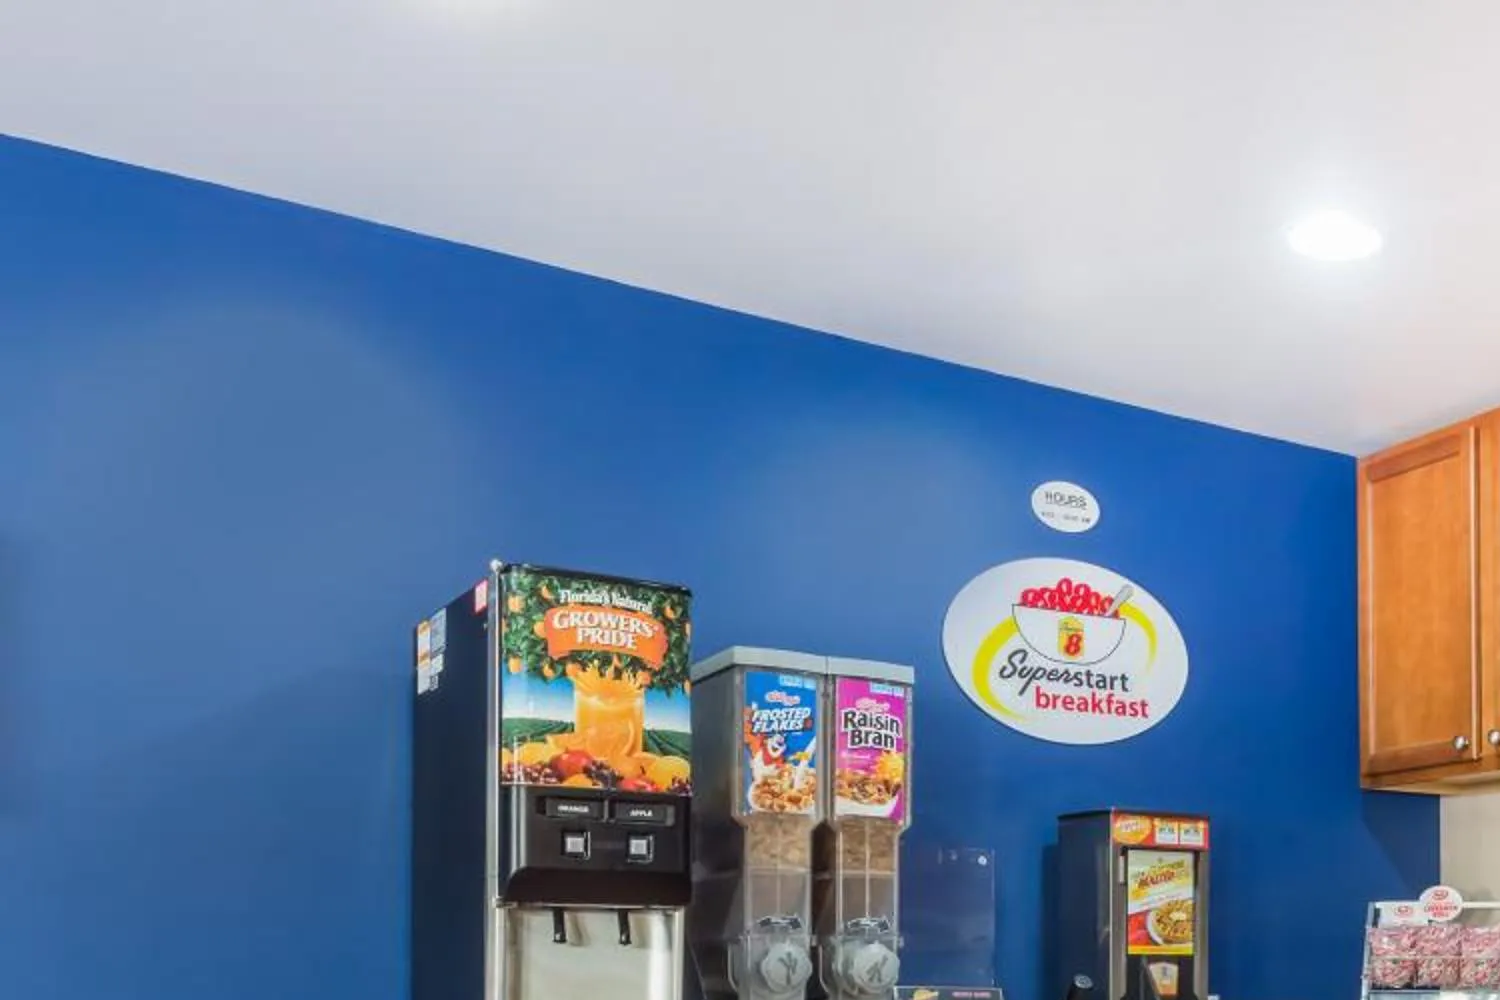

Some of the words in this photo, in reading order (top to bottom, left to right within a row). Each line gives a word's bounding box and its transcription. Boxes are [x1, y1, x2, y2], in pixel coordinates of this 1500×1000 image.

[611, 591, 652, 615] Natural
[576, 627, 638, 651] PRIDE
[1063, 632, 1083, 657] 8
[998, 648, 1130, 697] Superstart
[1034, 685, 1150, 719] breakfast
[752, 707, 812, 722] FROSTED
[752, 718, 805, 734] FLAKES
[843, 710, 900, 735] Raisin
[850, 730, 895, 749] Bran
